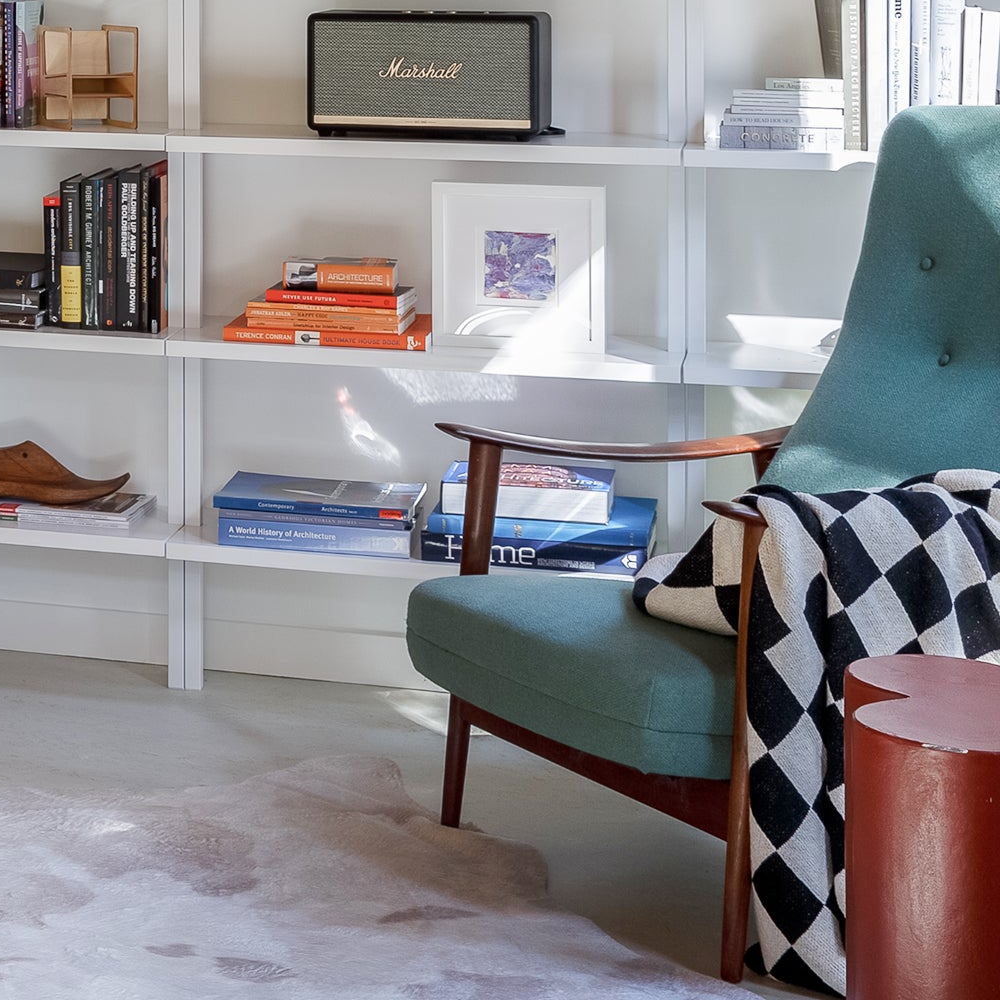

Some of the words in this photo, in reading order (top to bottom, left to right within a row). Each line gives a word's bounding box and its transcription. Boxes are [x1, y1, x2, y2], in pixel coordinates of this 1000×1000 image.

[849, 4, 858, 44] HISTORY
[379, 56, 463, 80] Marshall
[85, 187, 93, 213] ROBERT
[120, 205, 128, 258] GOLDBERGER
[130, 222, 137, 233] UP
[328, 272, 384, 282] ARCHITECTURE
[235, 331, 264, 339] TERENCE
[265, 332, 292, 341] CONRAN
[235, 527, 257, 535] World
[258, 528, 283, 538] History
[293, 531, 337, 541] Architecture
